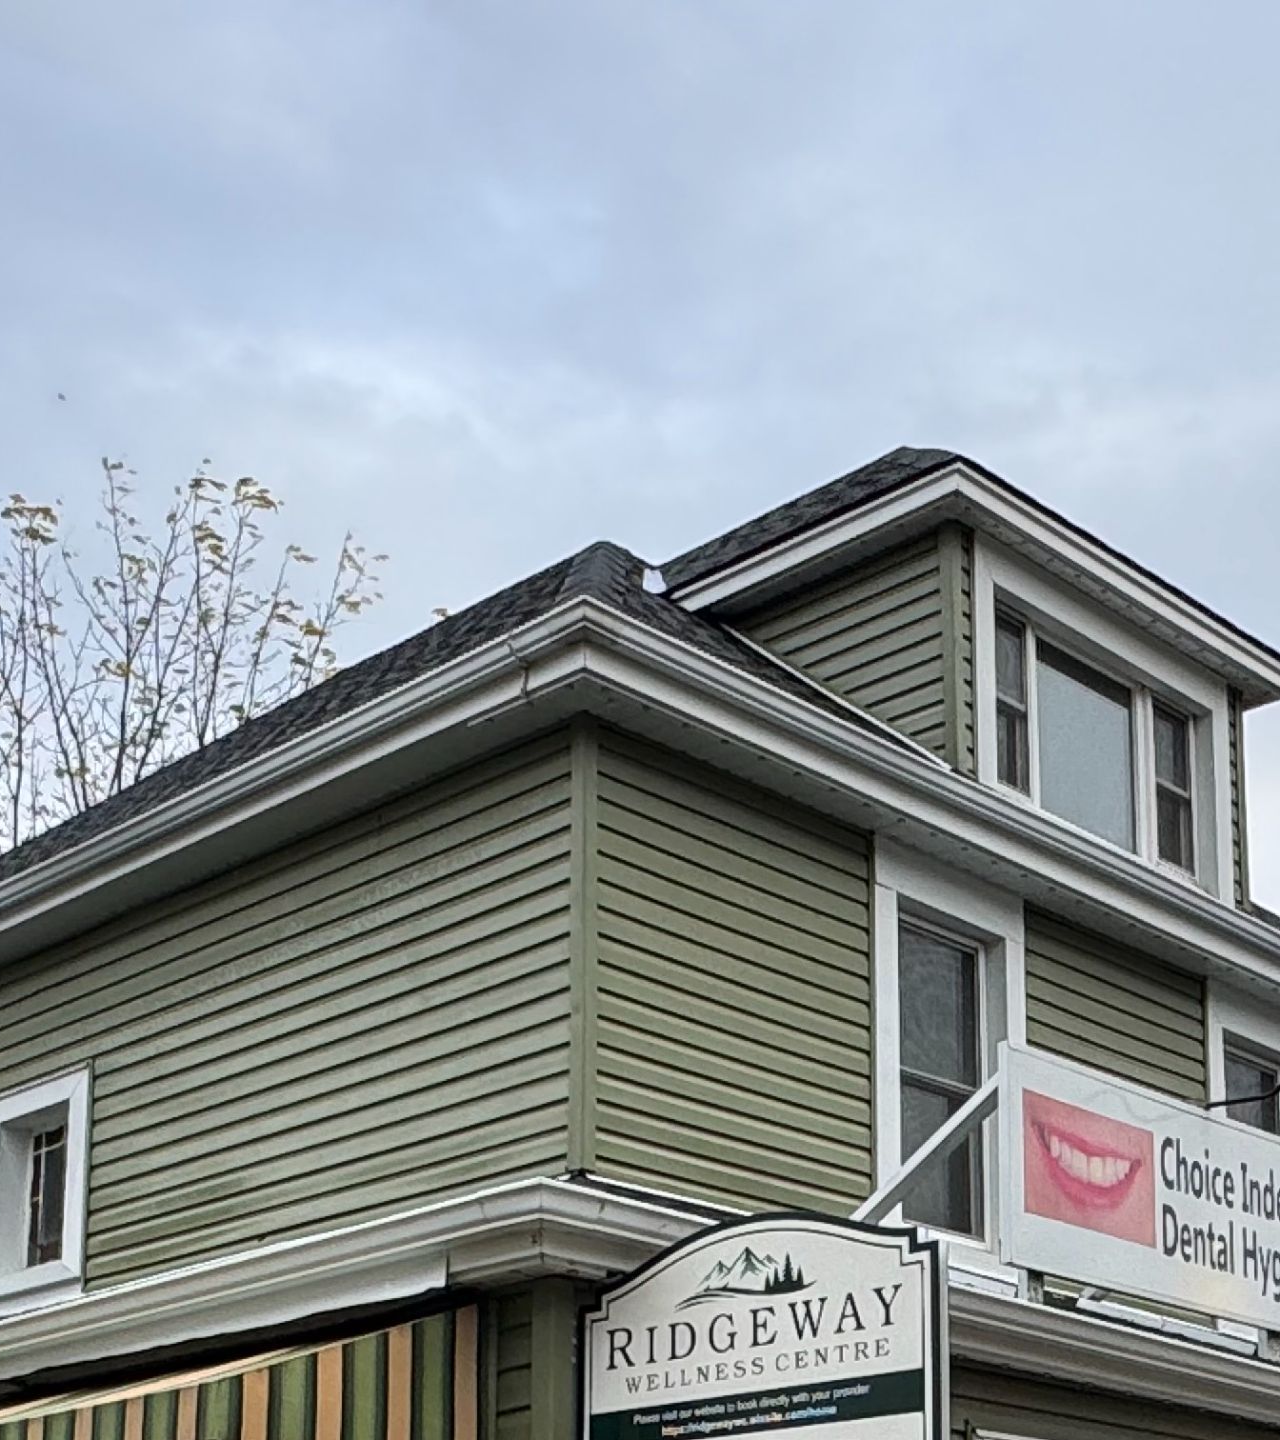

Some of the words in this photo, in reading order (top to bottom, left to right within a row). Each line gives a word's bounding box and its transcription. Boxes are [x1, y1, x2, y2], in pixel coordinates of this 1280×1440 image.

[1160, 1136, 1235, 1209] Choice
[1162, 1203, 1235, 1275] Dental
[606, 1283, 903, 1371] RIDGEWAY
[625, 1357, 765, 1395] WELLNESS
[775, 1337, 891, 1372] CENTRE
[737, 1398, 758, 1411] book
[759, 1394, 790, 1409] directly
[791, 1392, 810, 1404] with
[811, 1390, 831, 1403] your
